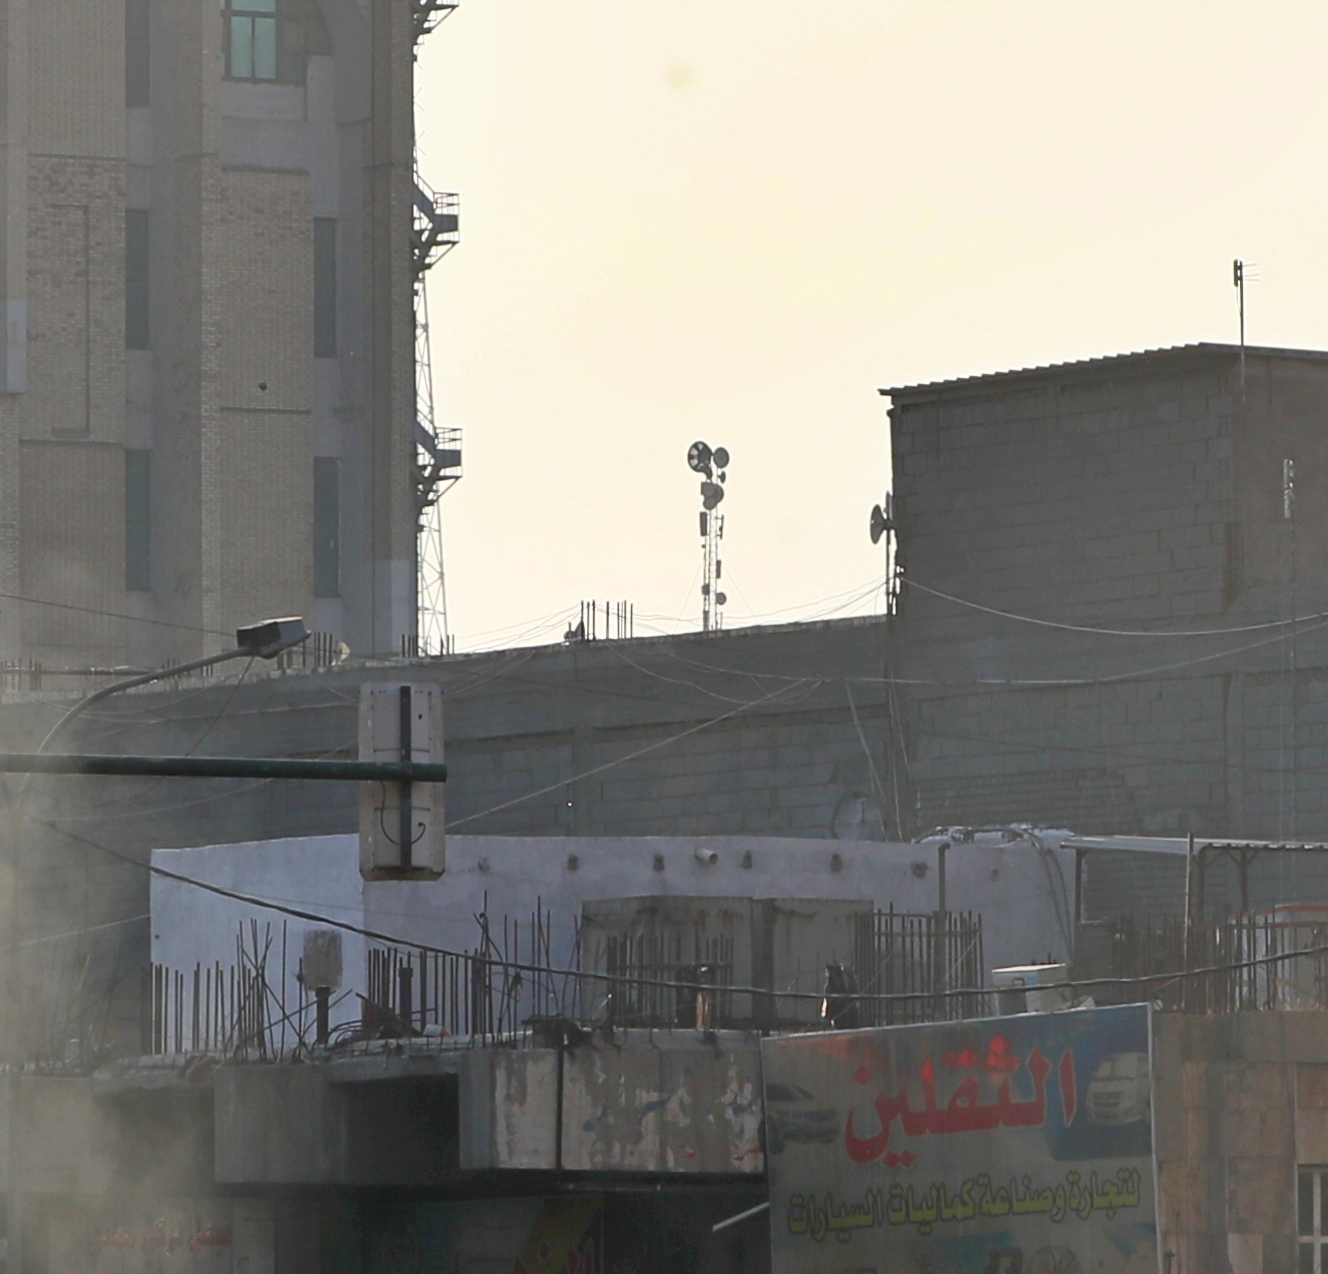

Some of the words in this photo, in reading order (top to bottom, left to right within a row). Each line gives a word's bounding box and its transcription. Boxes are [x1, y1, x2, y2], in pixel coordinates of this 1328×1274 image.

[844, 1034, 1077, 1169] الثقلين
[786, 1186, 884, 1245] السيارات
[887, 1177, 976, 1237] كماليات
[979, 1173, 1068, 1225] وصناعة
